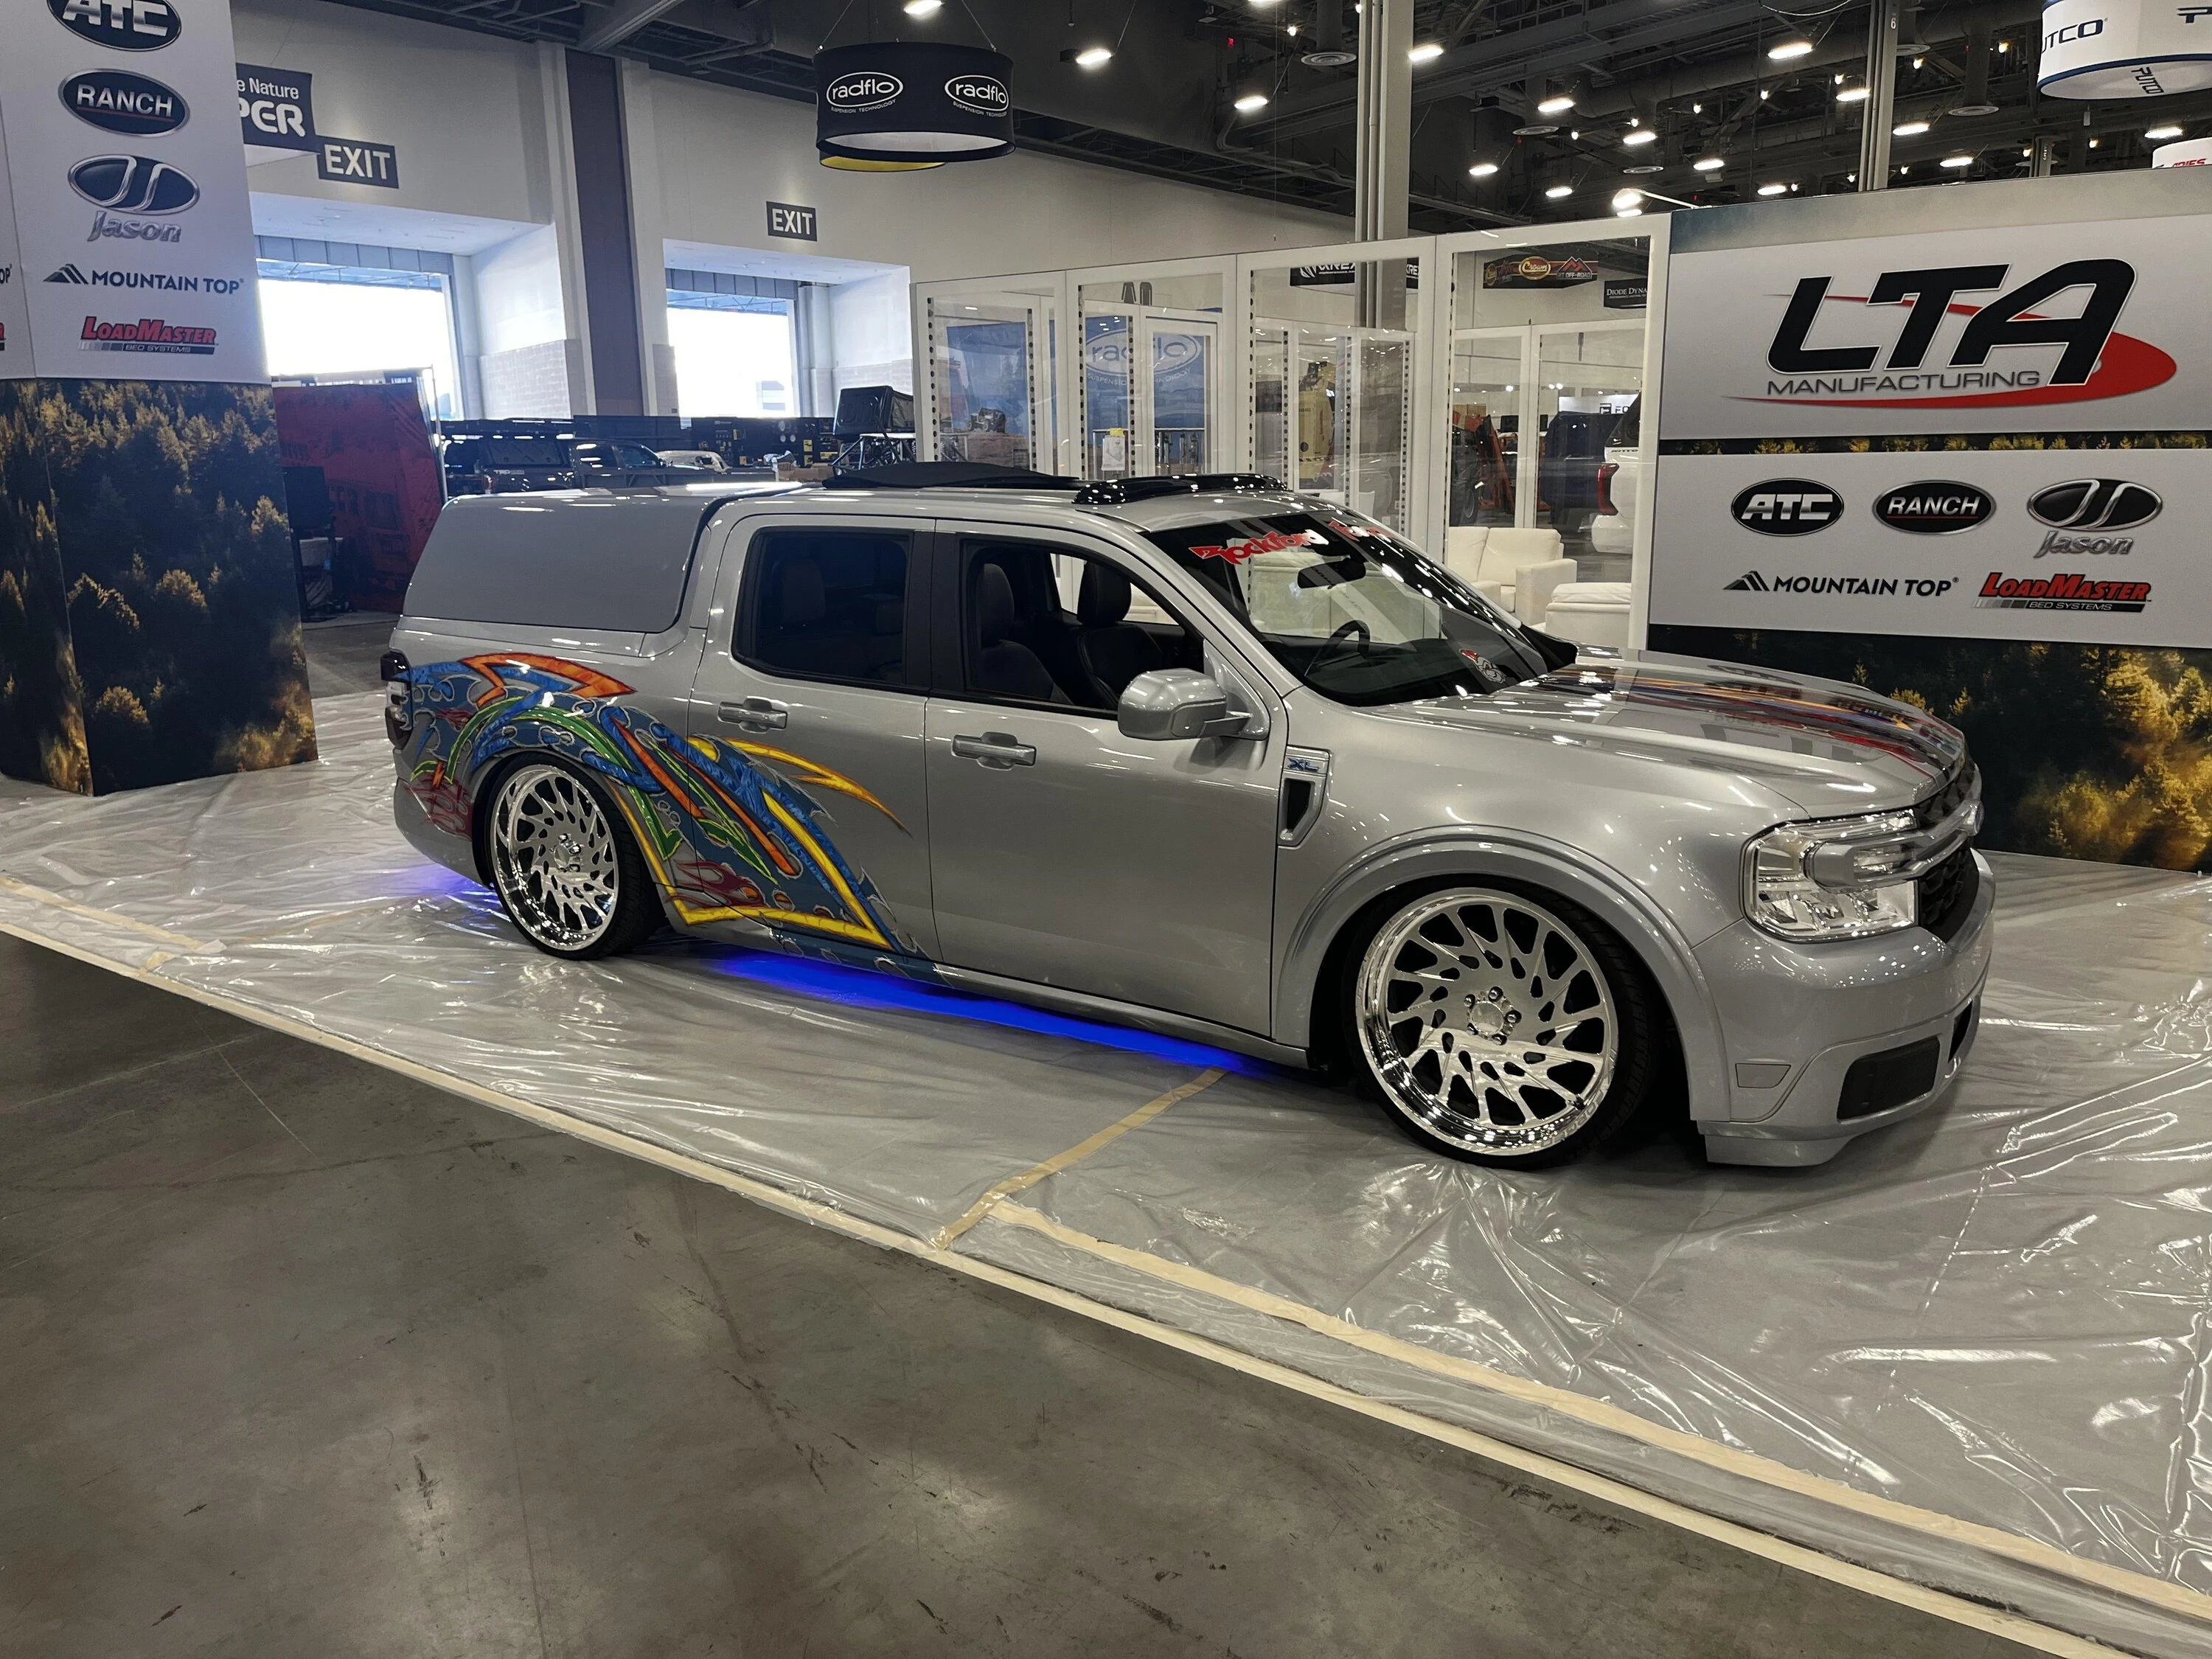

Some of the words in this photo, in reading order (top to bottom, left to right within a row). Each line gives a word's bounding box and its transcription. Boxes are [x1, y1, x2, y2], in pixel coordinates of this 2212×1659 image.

[63, 0, 169, 37] ATC
[77, 83, 173, 117] RANCH
[249, 77, 299, 100] Nature
[832, 78, 894, 100] radflo
[956, 83, 1006, 104] radflo
[858, 99, 896, 113] TECHNOLOGY
[324, 144, 391, 180] EXIT
[87, 210, 182, 243] Jason
[772, 208, 813, 235] EXIT
[1522, 260, 1548, 273] Crown
[92, 270, 198, 292] MOUNTAIN
[1766, 258, 2136, 386] LTA
[147, 345, 191, 353] SYSTEMS
[1767, 370, 2041, 395] MANUFACTURING
[1741, 494, 1833, 520] ATC
[1887, 496, 1980, 515] RANCH
[2033, 530, 2134, 559] Jason
[1773, 575, 1898, 596] MOUNTAIN
[2029, 601, 2053, 609] BED
[2056, 602, 2113, 611] SYSTEMS
